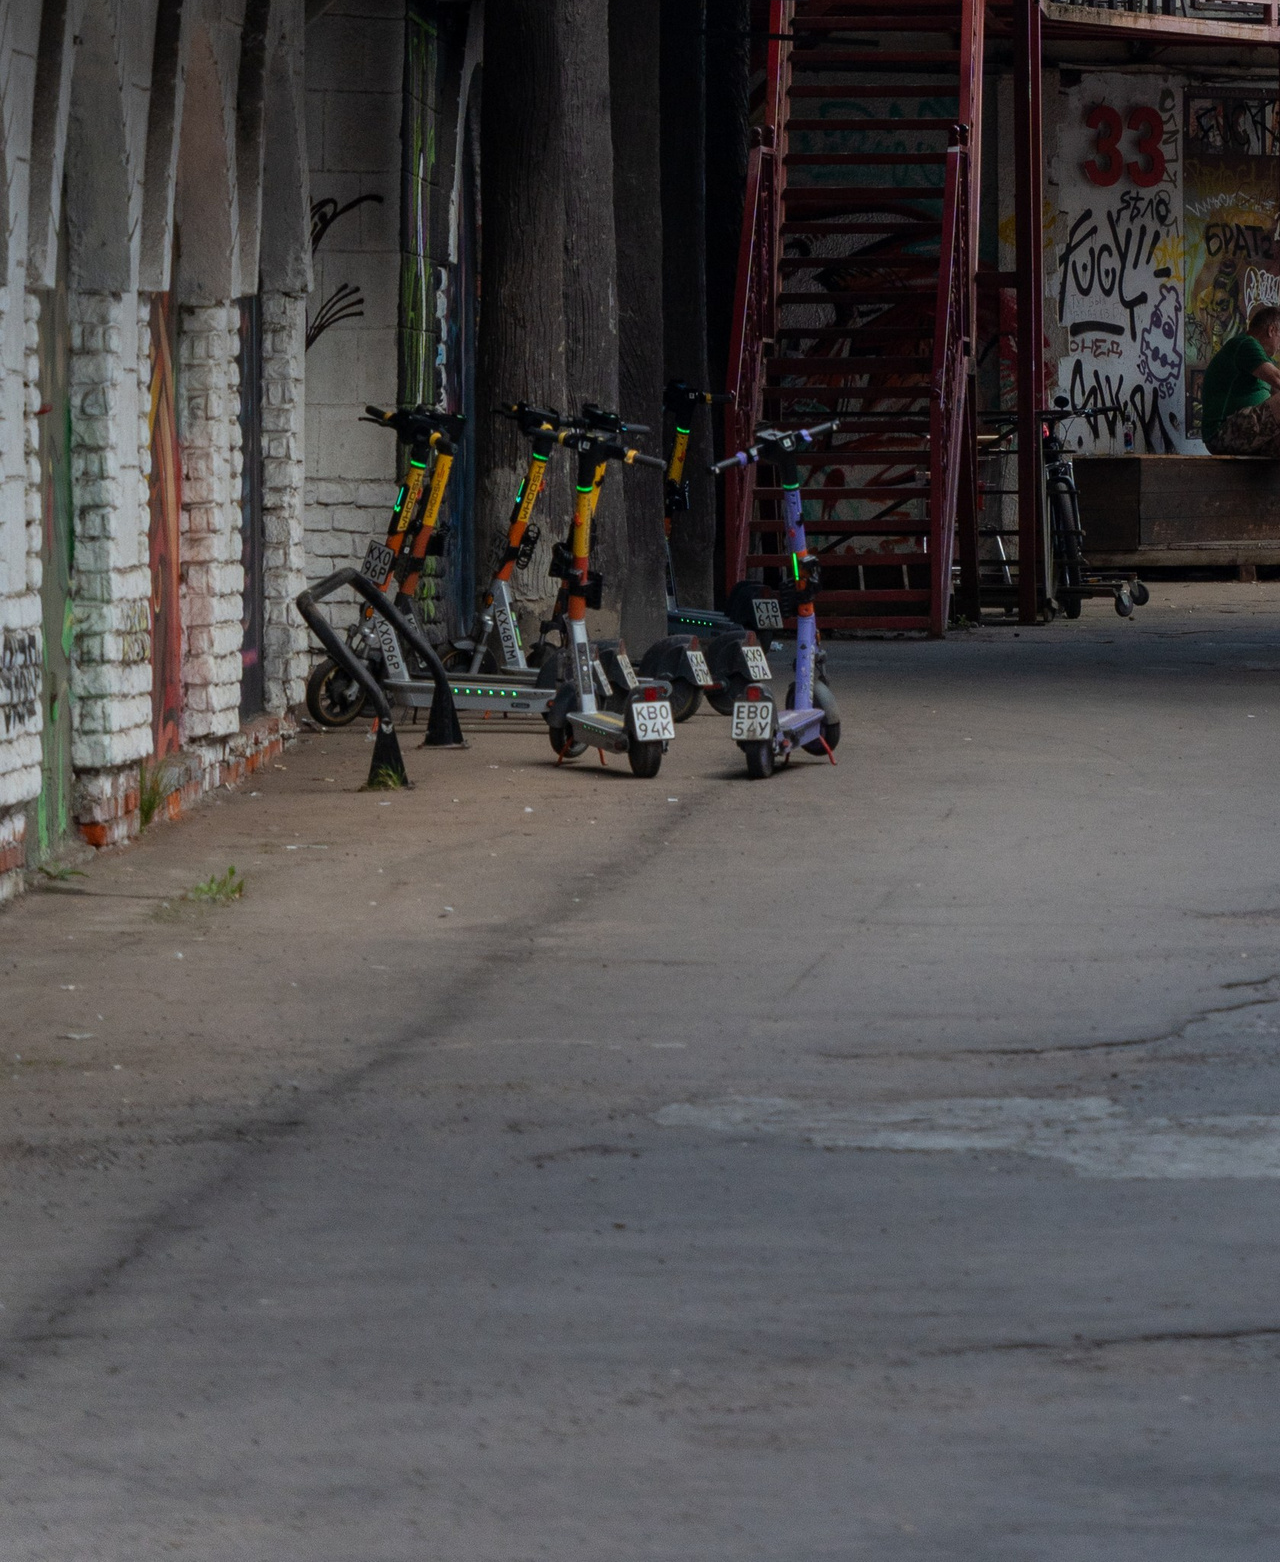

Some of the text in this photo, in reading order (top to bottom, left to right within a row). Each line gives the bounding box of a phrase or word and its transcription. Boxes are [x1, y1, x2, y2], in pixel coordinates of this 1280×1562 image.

[1084, 105, 1166, 187] 33
[399, 472, 422, 530] WHOOSH
[520, 465, 542, 520] WHOOSH
